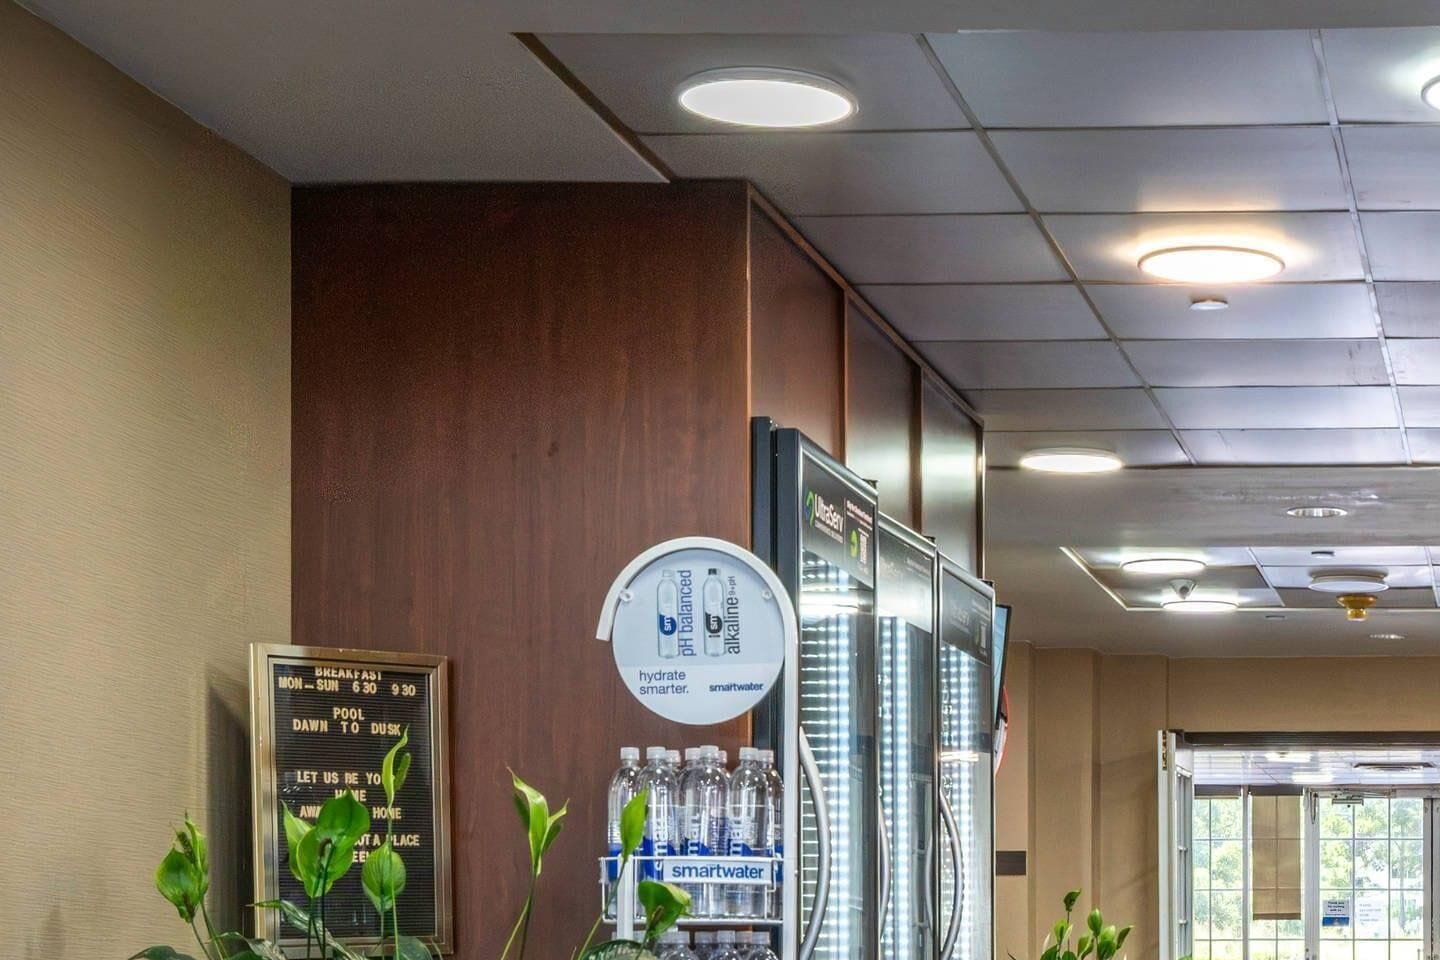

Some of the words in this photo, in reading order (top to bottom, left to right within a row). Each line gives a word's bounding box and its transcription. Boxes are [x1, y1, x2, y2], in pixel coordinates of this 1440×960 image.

[677, 570, 694, 633] balanced
[724, 597, 741, 655] alkaline
[678, 638, 697, 656] pH
[639, 670, 686, 684] hydrate
[639, 683, 689, 695] smarter.
[709, 682, 764, 692] smartwater
[332, 707, 365, 720] POOL
[292, 719, 328, 732] DAWN
[340, 722, 360, 733] TO
[371, 723, 401, 736] DUSK
[297, 771, 318, 783] LET
[323, 772, 339, 784] US
[345, 773, 359, 784] BE
[335, 790, 367, 802] HME
[671, 863, 765, 879] smartwater
